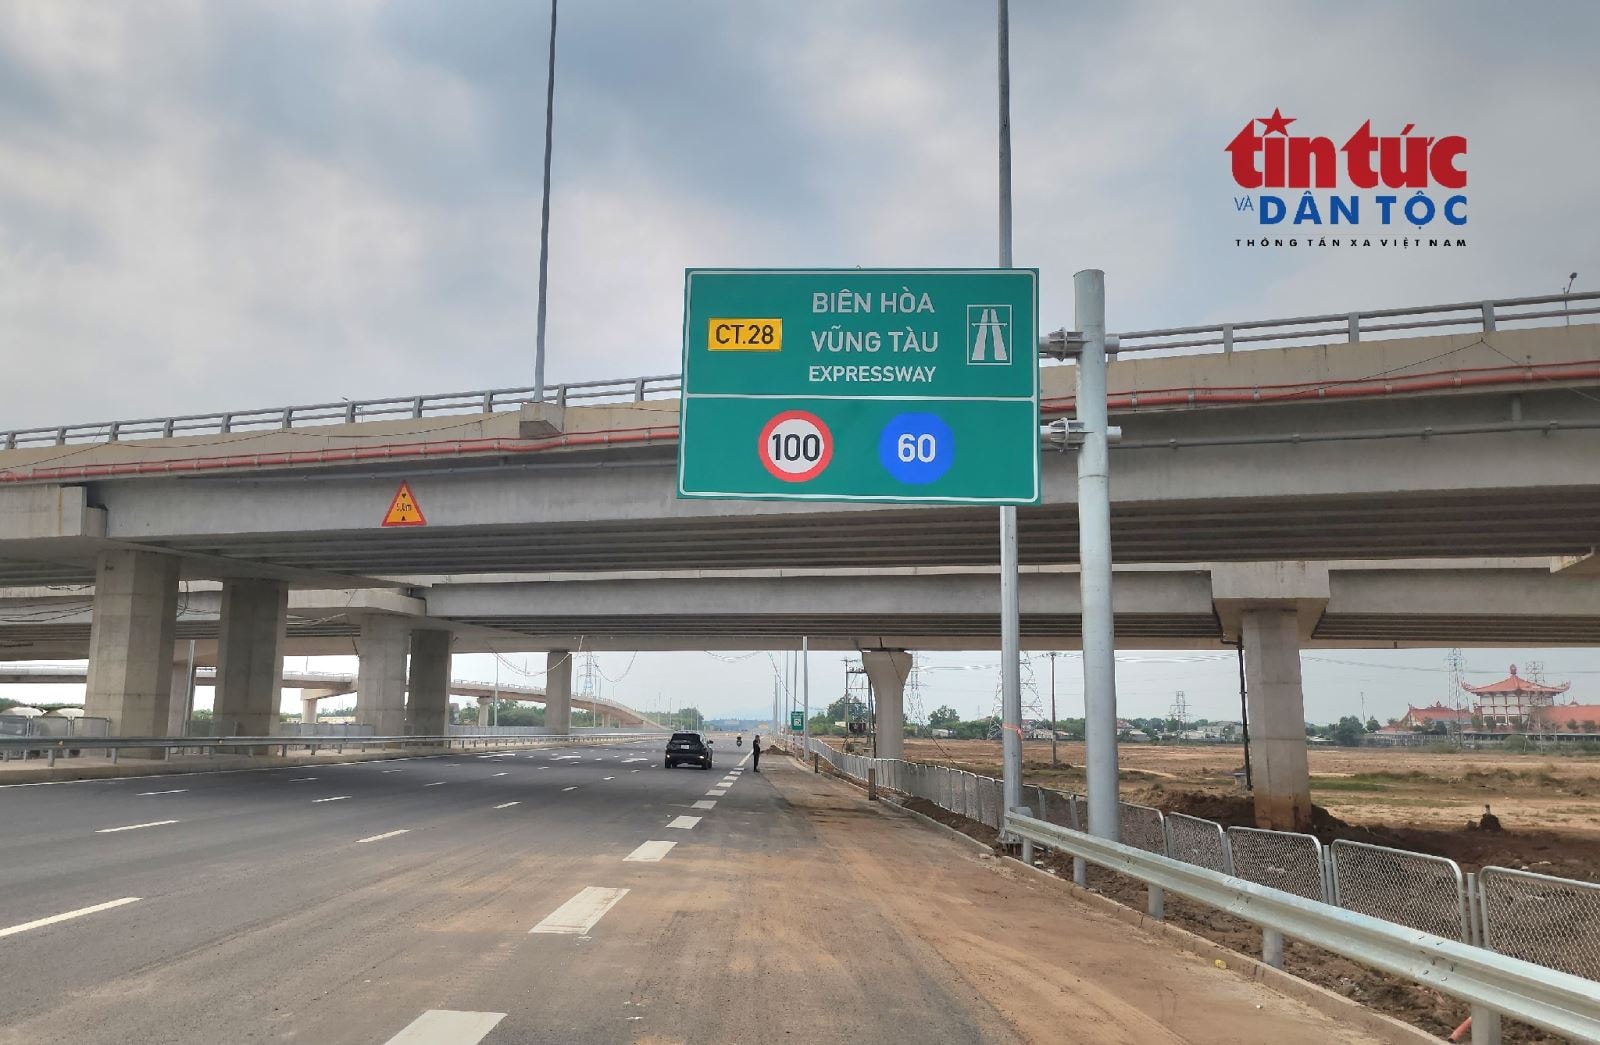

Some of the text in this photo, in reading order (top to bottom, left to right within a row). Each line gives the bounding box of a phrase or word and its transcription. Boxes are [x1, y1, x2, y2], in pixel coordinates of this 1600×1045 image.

[812, 286, 935, 313] BIÊN HÒA
[715, 324, 774, 345] CT.28
[811, 325, 939, 352] VŨNG TÀU
[808, 365, 937, 383] EXPRESSWAY
[771, 434, 821, 462] 100
[897, 434, 936, 463] 60
